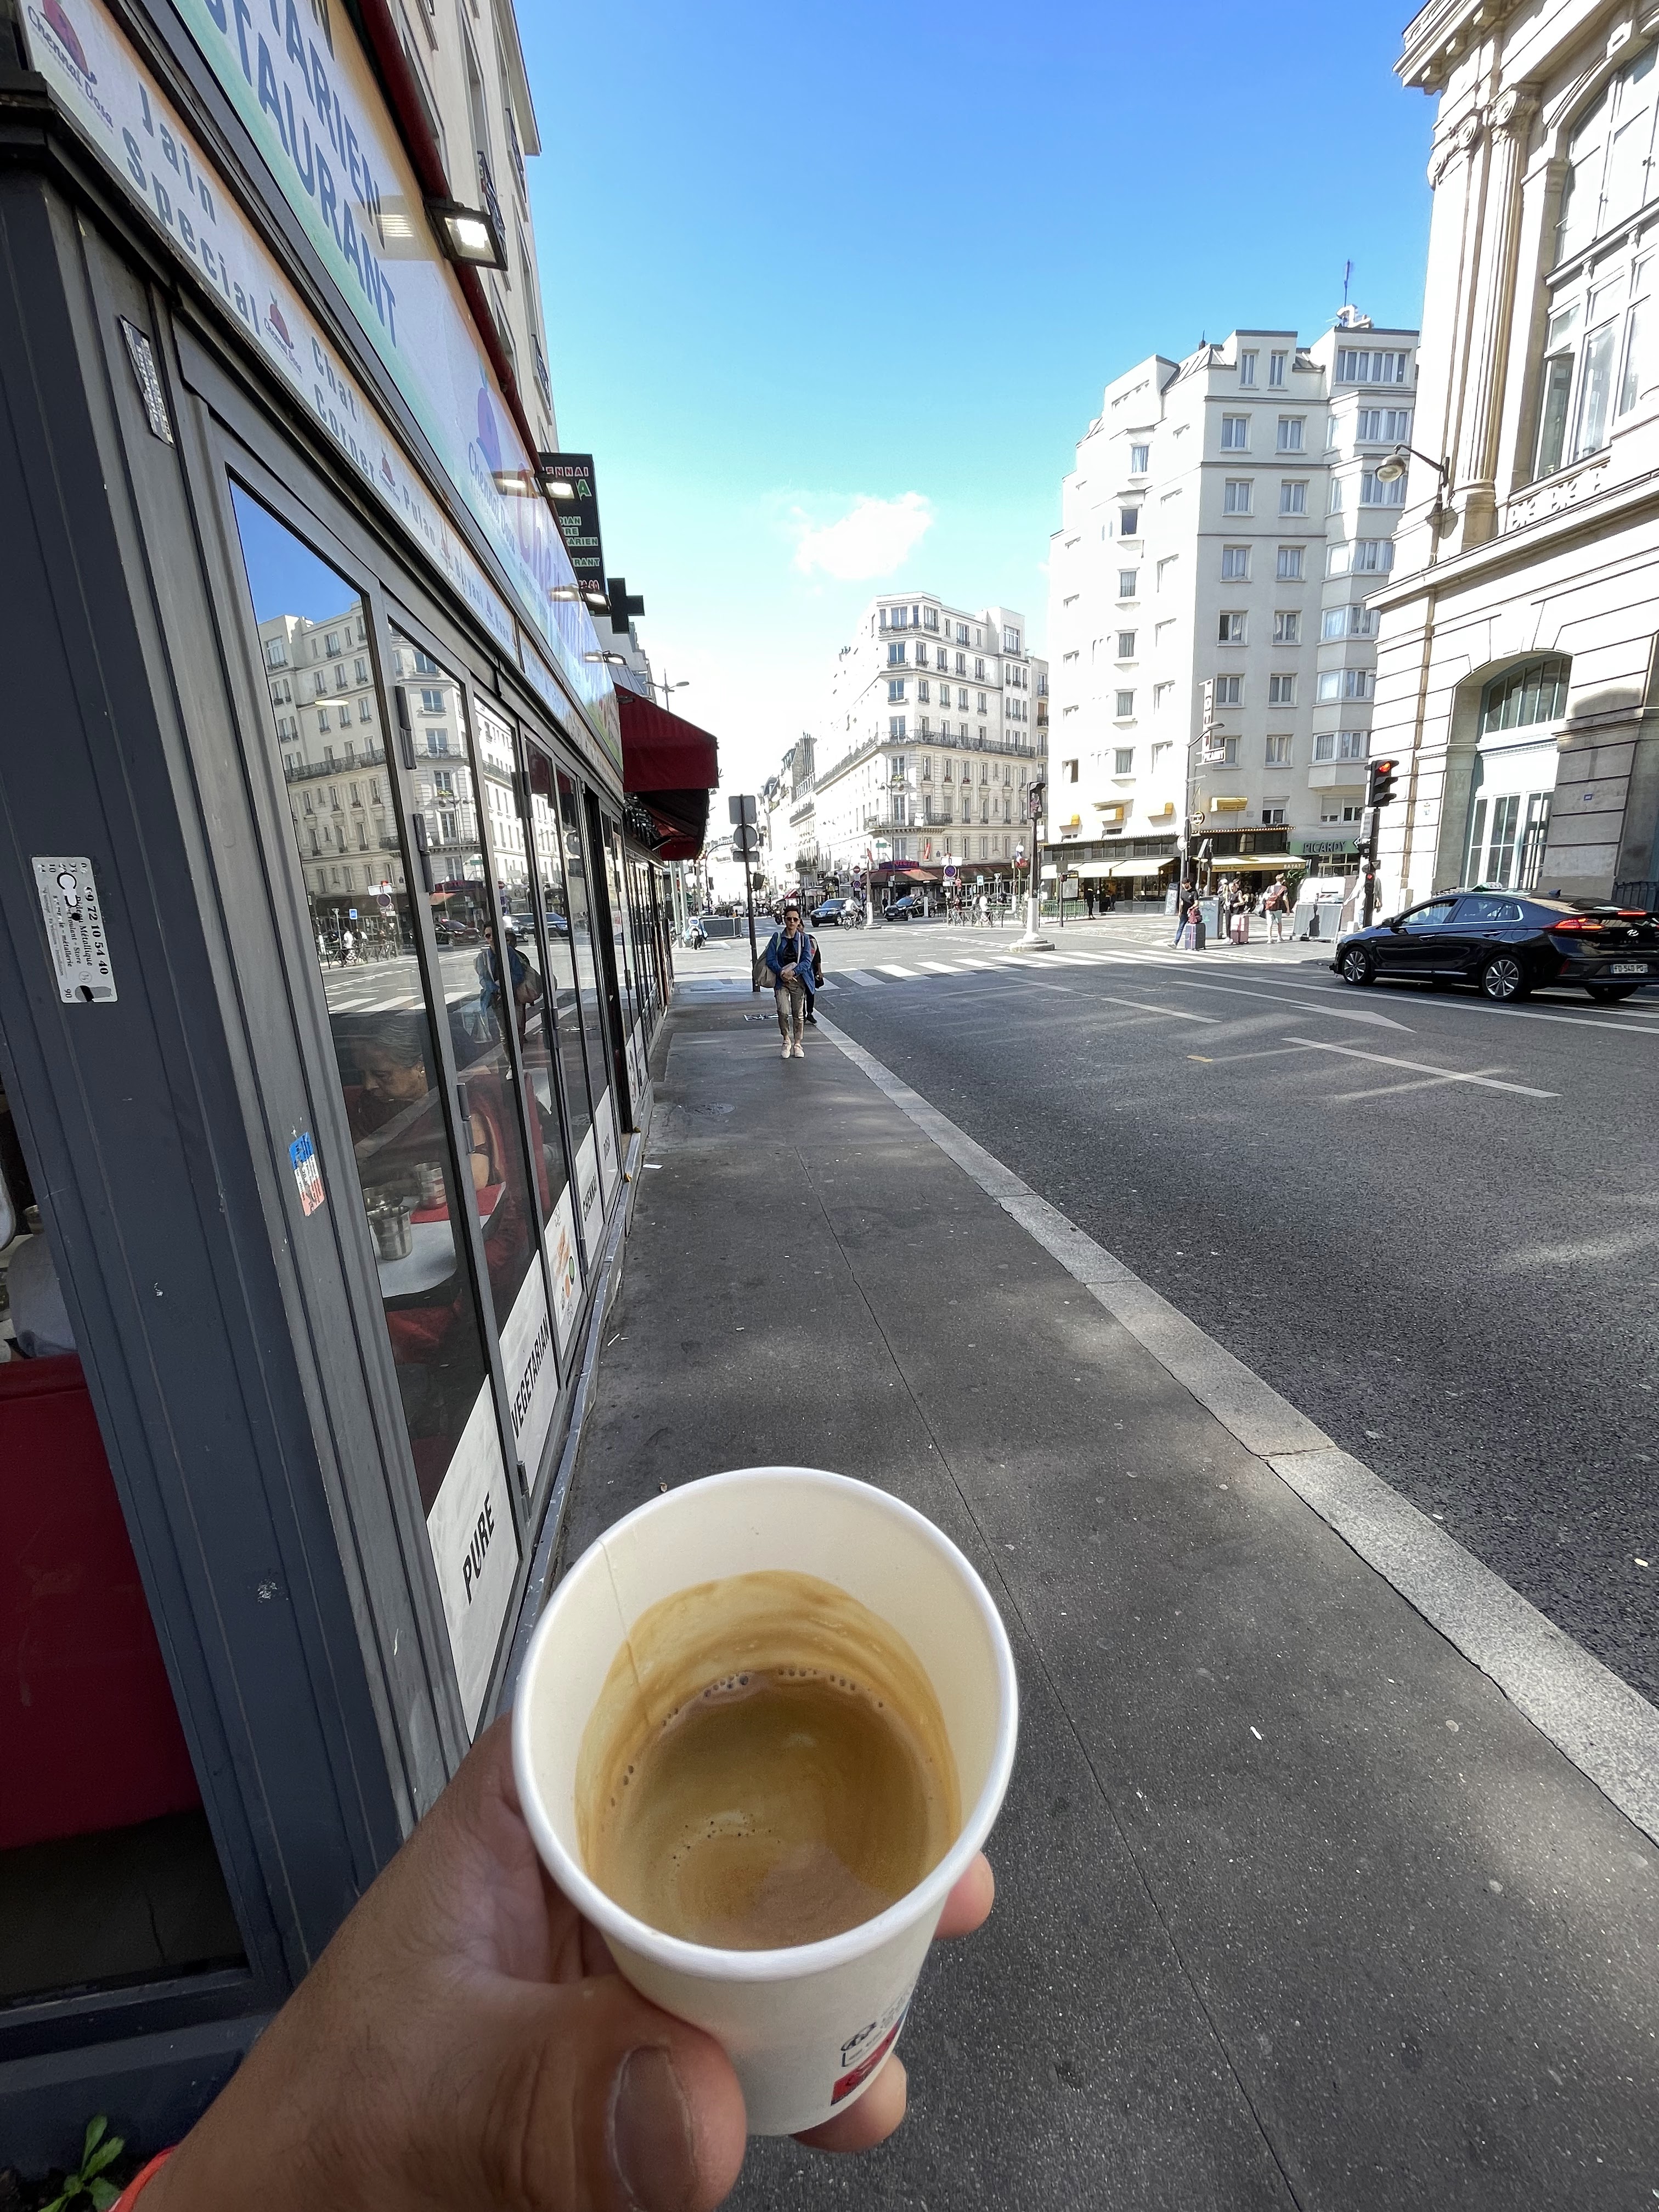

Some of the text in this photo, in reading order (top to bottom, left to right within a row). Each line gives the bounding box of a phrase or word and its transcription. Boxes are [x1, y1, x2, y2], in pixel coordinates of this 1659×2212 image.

[28, 5, 114, 128] Chennai Dosa
[138, 81, 216, 225] Jain
[122, 127, 261, 337] Special
[312, 336, 357, 422] Chat
[314, 383, 375, 483] Corner
[542, 466, 589, 477] ENNAI
[402, 485, 436, 547] Pulao
[562, 527, 579, 536] RE
[572, 557, 600, 567] RANT
[1303, 842, 1346, 853] PICARDY
[86, 905, 98, 921] 72
[90, 924, 101, 938] 10
[73, 947, 83, 964] Store
[77, 926, 95, 966] Métallique
[94, 941, 105, 956] 54
[98, 960, 109, 974] 40
[511, 1313, 549, 1440] VEGETARIAN
[463, 1491, 494, 1606] PURE
